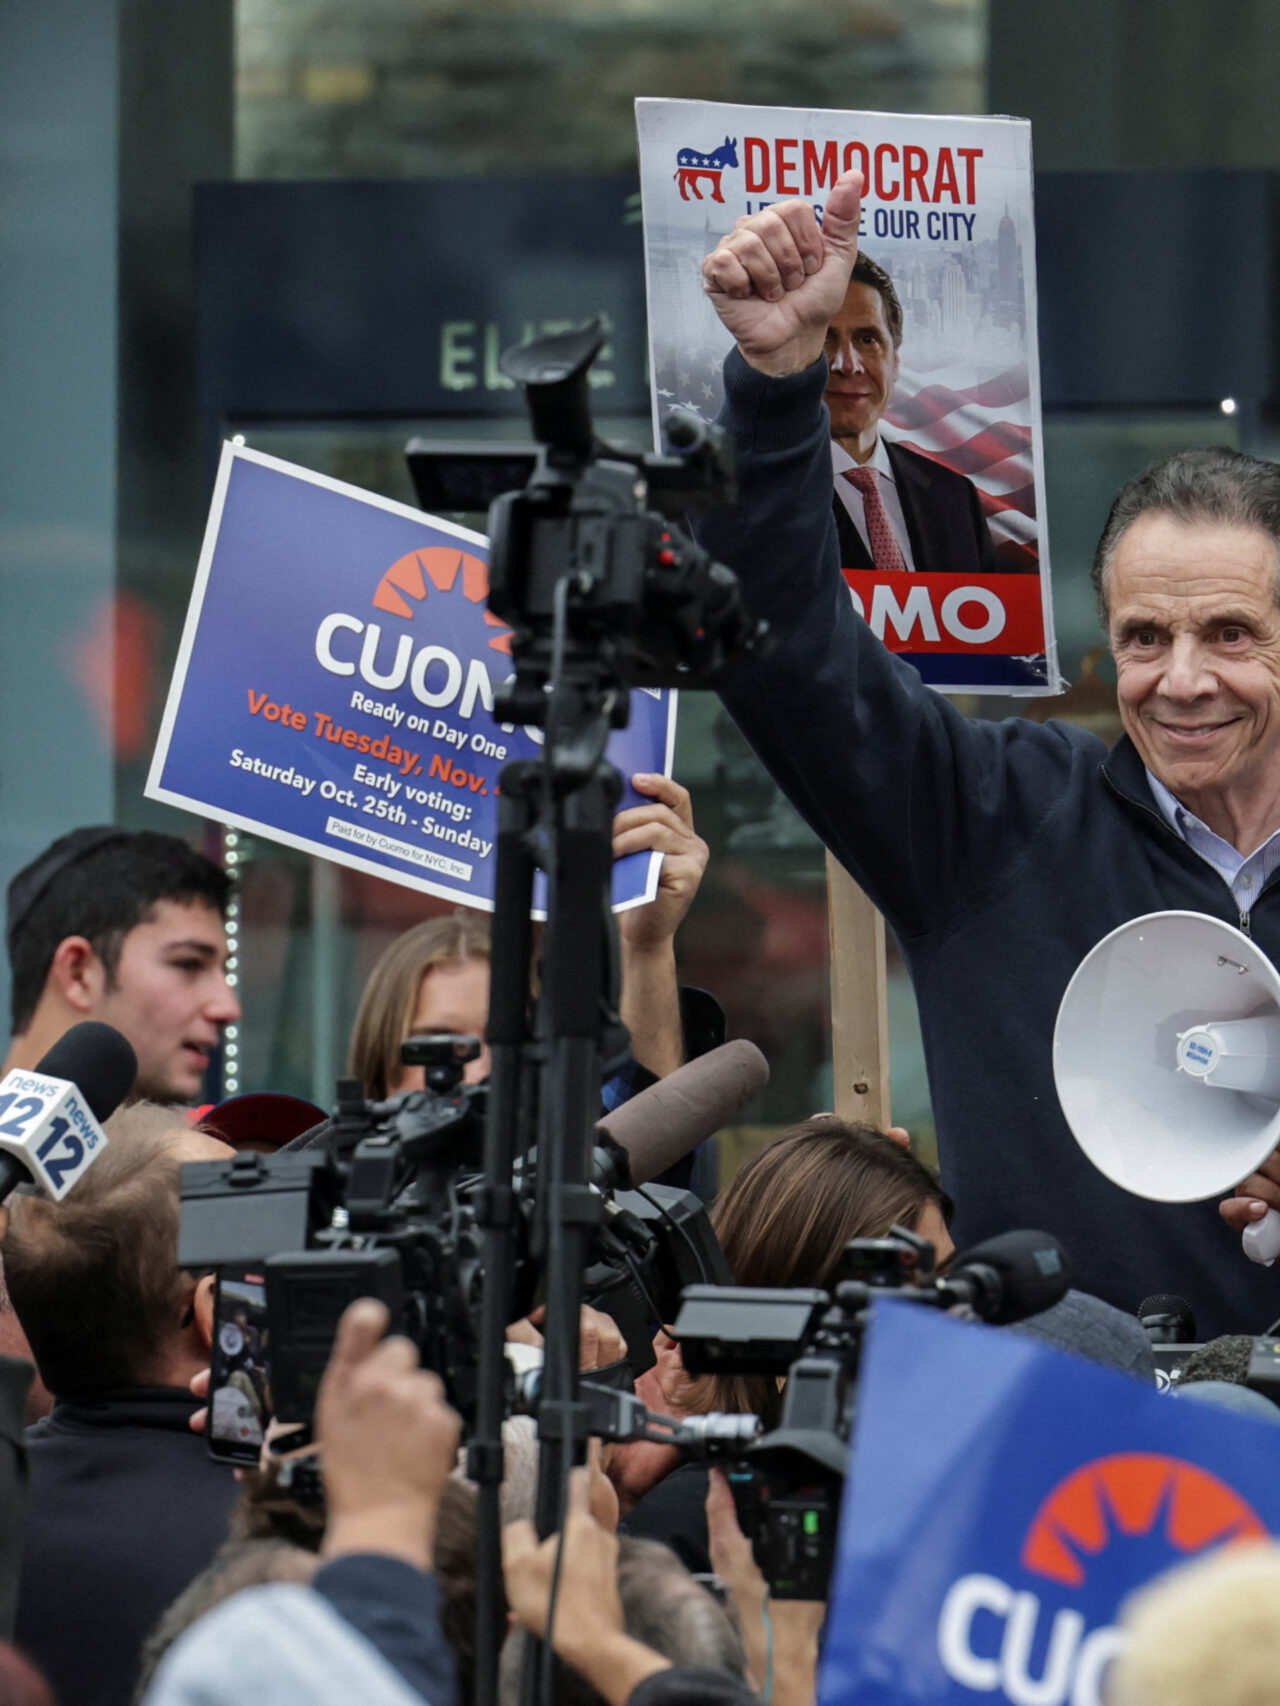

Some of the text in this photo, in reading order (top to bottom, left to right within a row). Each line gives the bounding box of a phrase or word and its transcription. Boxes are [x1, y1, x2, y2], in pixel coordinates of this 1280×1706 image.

[744, 136, 983, 205] DEMOCRAT
[874, 208, 920, 240] OUR
[926, 211, 976, 241] CITY
[315, 612, 545, 745] CUOM
[247, 688, 488, 796] Vote Tuesday, Nov.
[350, 690, 507, 760] Ready on Day One
[229, 748, 316, 796] Saturday
[319, 780, 358, 808] Oct.
[362, 795, 407, 826] 25th
[421, 815, 493, 859] Sunday
[352, 764, 472, 822] Early voting:
[331, 820, 351, 836] Paid
[353, 829, 365, 840] for
[366, 834, 378, 847] by
[378, 838, 410, 856] Cuomo
[411, 849, 424, 861] for
[9, 1076, 59, 1097] news
[36, 1115, 84, 1191] 12
[64, 1096, 100, 1150] news
